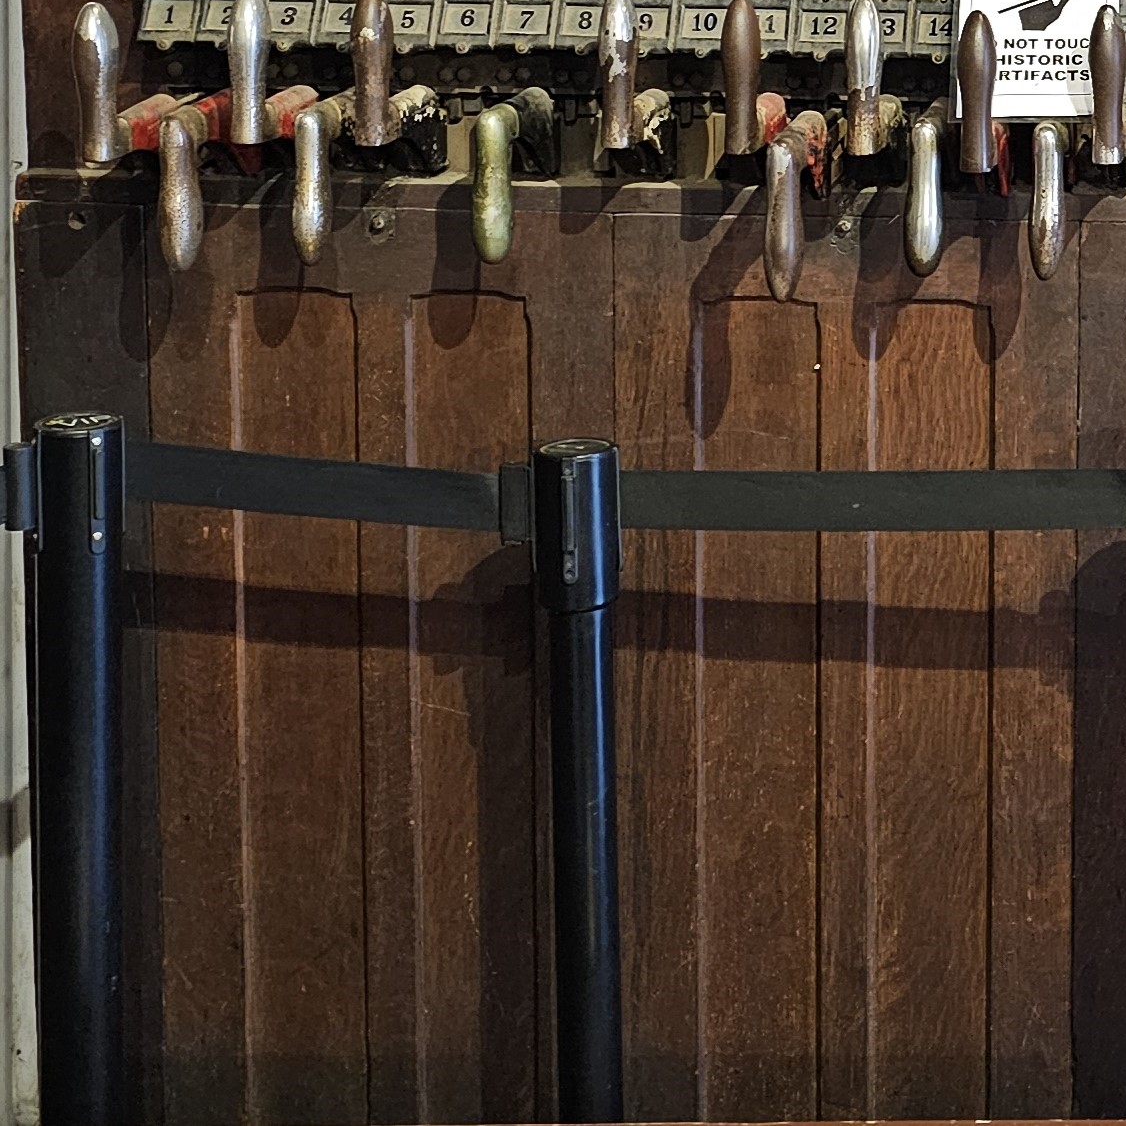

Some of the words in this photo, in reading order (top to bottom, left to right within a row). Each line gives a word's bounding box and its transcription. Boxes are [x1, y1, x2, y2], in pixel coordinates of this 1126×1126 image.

[164, 4, 175, 24] 1
[221, 6, 232, 24] 2
[280, 6, 298, 25] 3
[338, 7, 352, 25] 4
[400, 10, 415, 28] 5
[460, 9, 476, 27] 6
[519, 10, 535, 29] 7
[578, 10, 593, 29] 8
[638, 13, 654, 31] 9
[691, 12, 718, 32] 10
[810, 16, 838, 35] 12
[928, 17, 951, 36] 14
[1003, 38, 1039, 49] NOT
[1043, 38, 1090, 49] TOUC
[996, 69, 1090, 81] RTIFACTS
